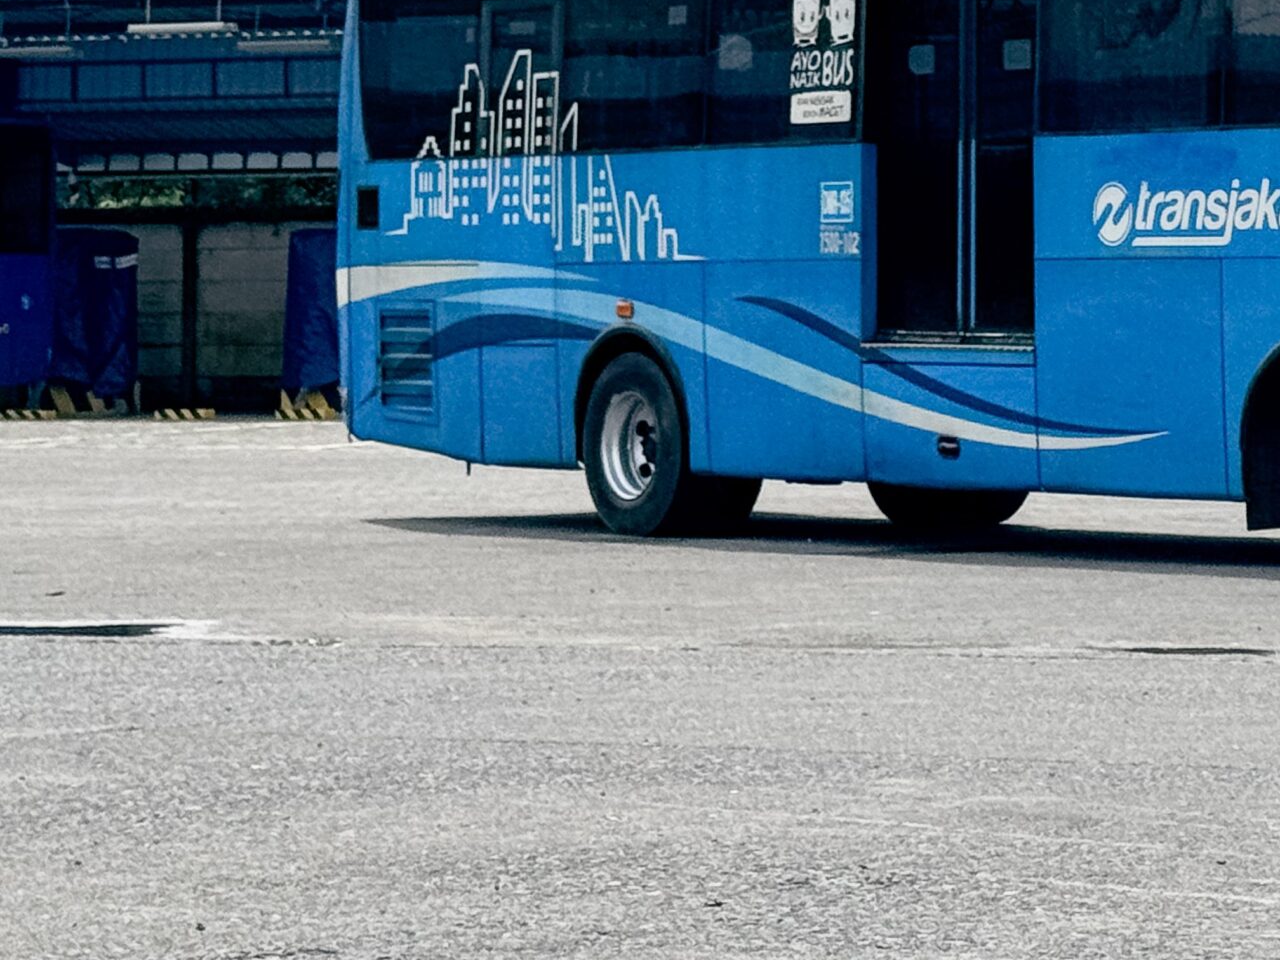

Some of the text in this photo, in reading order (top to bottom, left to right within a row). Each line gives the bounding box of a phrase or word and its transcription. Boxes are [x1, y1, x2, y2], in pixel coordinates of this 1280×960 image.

[790, 48, 855, 89] NAIK BUS
[791, 50, 821, 71] AYO
